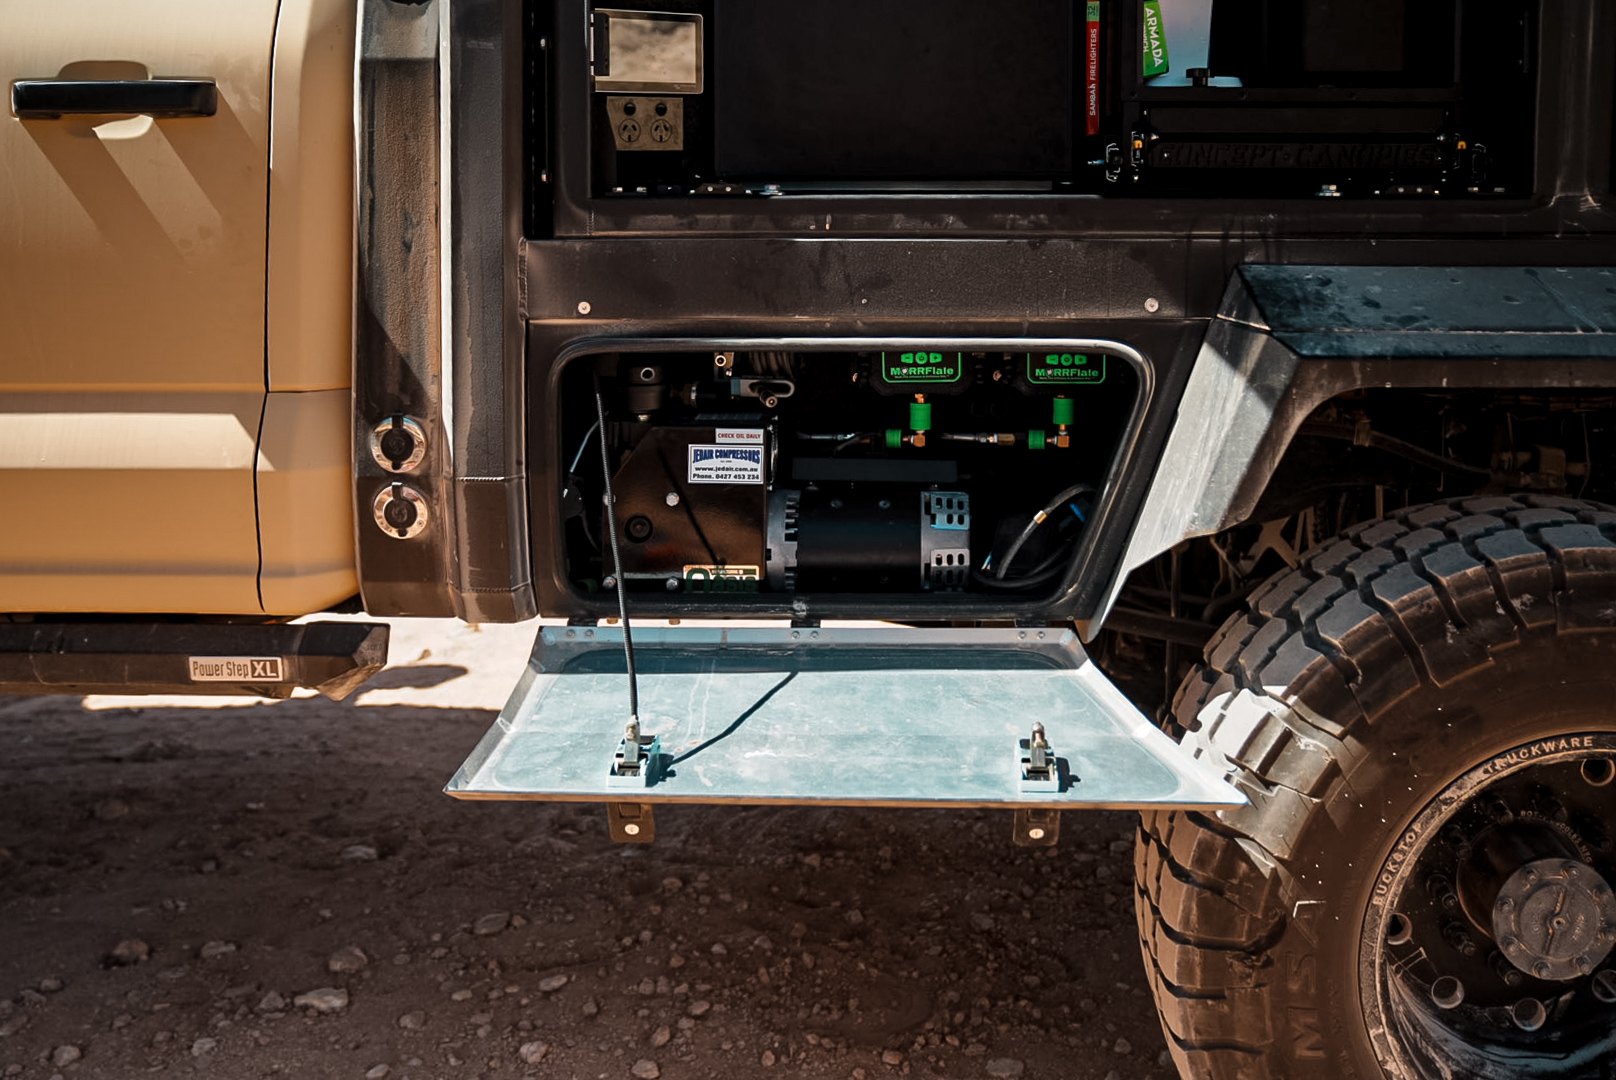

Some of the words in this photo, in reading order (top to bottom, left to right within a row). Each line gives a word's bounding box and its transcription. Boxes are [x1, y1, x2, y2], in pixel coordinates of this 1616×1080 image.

[1087, 5, 1096, 17] 32
[1145, 7, 1165, 68] ARMADA
[1089, 28, 1098, 81] FIRELIGHTERS
[1089, 89, 1097, 116] SAMBA
[692, 449, 714, 463] JEDAIR
[715, 449, 761, 464] COMPRESSORS
[192, 661, 224, 677] Power
[226, 661, 249, 679] Step
[251, 661, 278, 677] XL
[1483, 735, 1595, 774] TRUCKWARE
